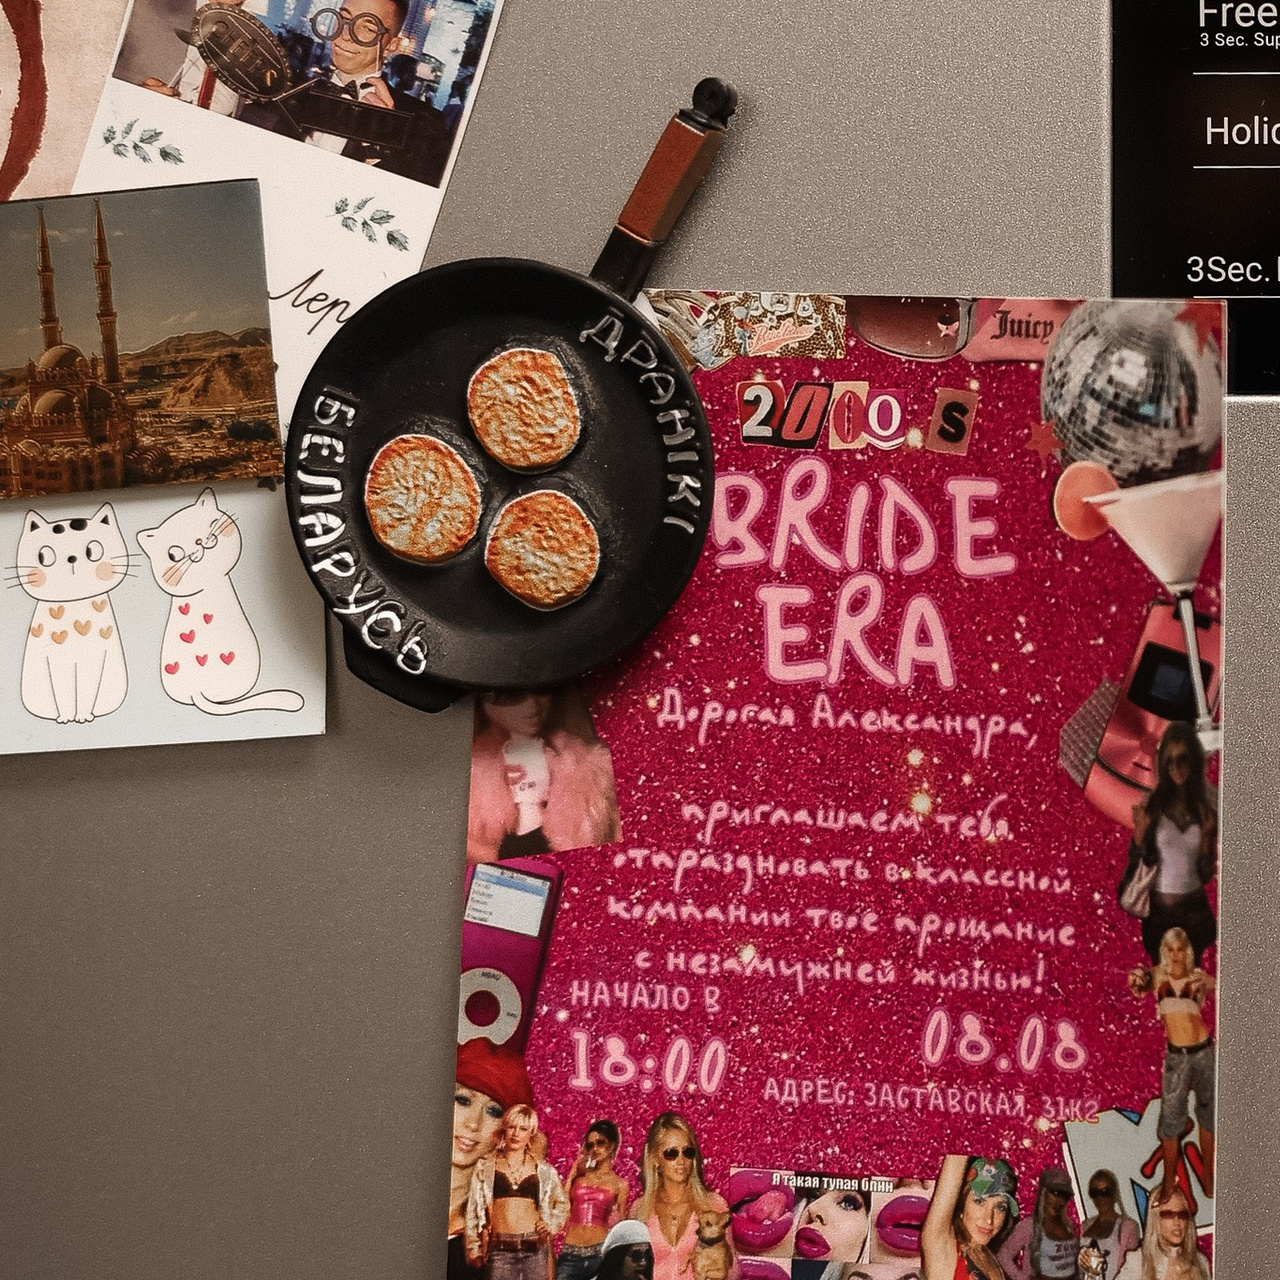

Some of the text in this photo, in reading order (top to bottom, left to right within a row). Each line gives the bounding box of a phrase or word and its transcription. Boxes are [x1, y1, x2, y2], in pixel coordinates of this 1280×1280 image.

[1200, 32, 1210, 47] 3
[1214, 32, 1249, 47] Sec.
[990, 310, 1055, 344] Juicy
[296, 387, 430, 676] БЕЛАРУСЬ
[712, 456, 1017, 579] BRIDE
[755, 572, 957, 690] ERA
[656, 686, 1038, 759] Дорогая Александра,
[681, 799, 921, 845] приглашаем
[612, 847, 869, 895] отпраздновать
[916, 862, 1072, 895] классной
[606, 895, 791, 928] компании
[894, 912, 1076, 958] прощание
[570, 980, 691, 1012] НАЧАЛО
[635, 950, 653, 970] с
[666, 949, 898, 995] незамужней
[568, 1030, 729, 1096] 18:00
[921, 1006, 1089, 1074] 08.08
[763, 1077, 856, 1108] АДРЕС:
[771, 1172, 894, 1194] Я такая тупая блин
